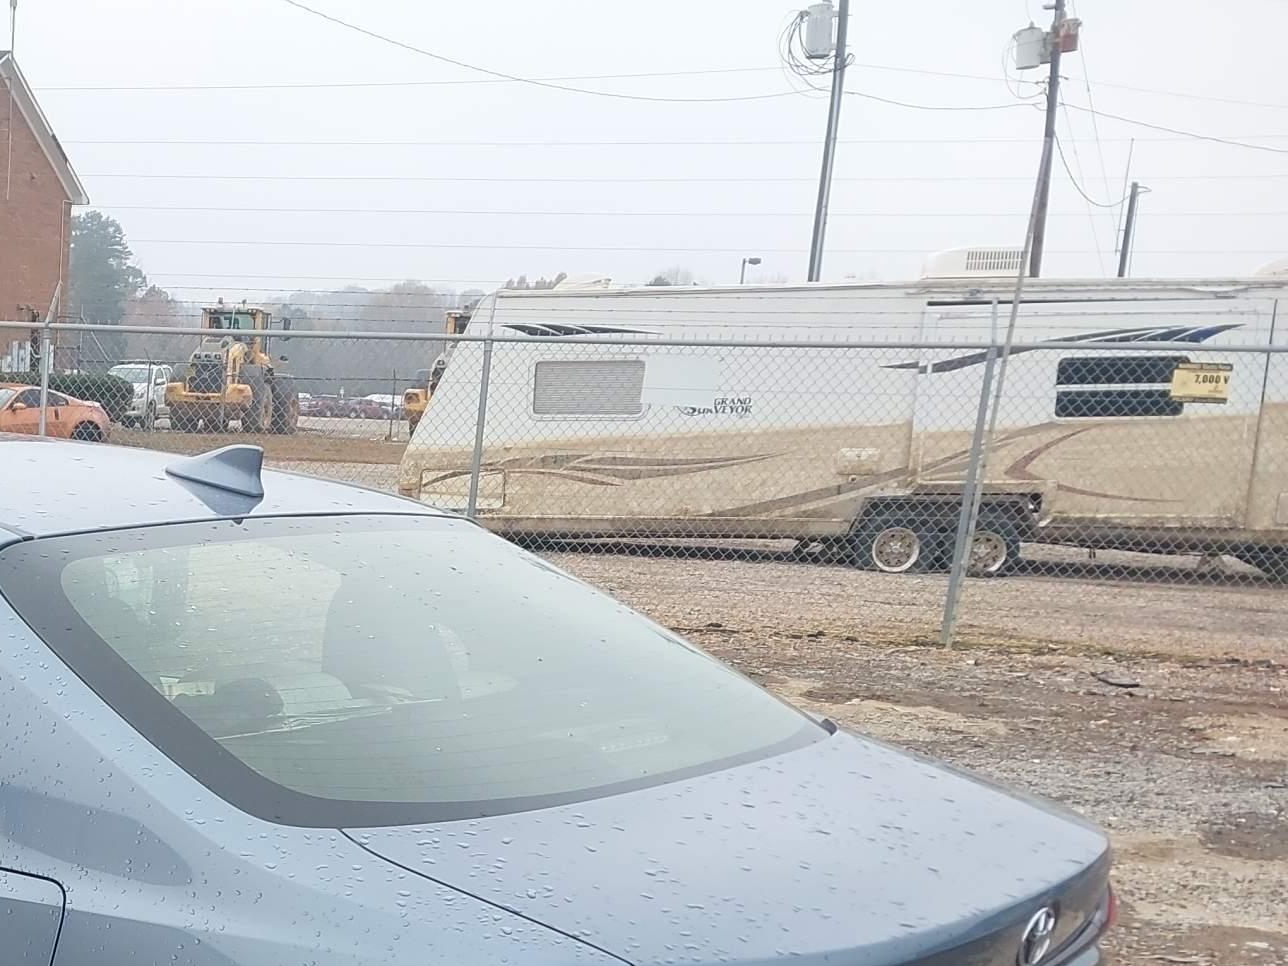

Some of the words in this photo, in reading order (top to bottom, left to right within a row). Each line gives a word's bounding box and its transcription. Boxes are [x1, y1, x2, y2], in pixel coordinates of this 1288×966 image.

[1194, 374, 1221, 385] 7,000
[1223, 375, 1230, 385] V
[713, 397, 752, 406] GRAND
